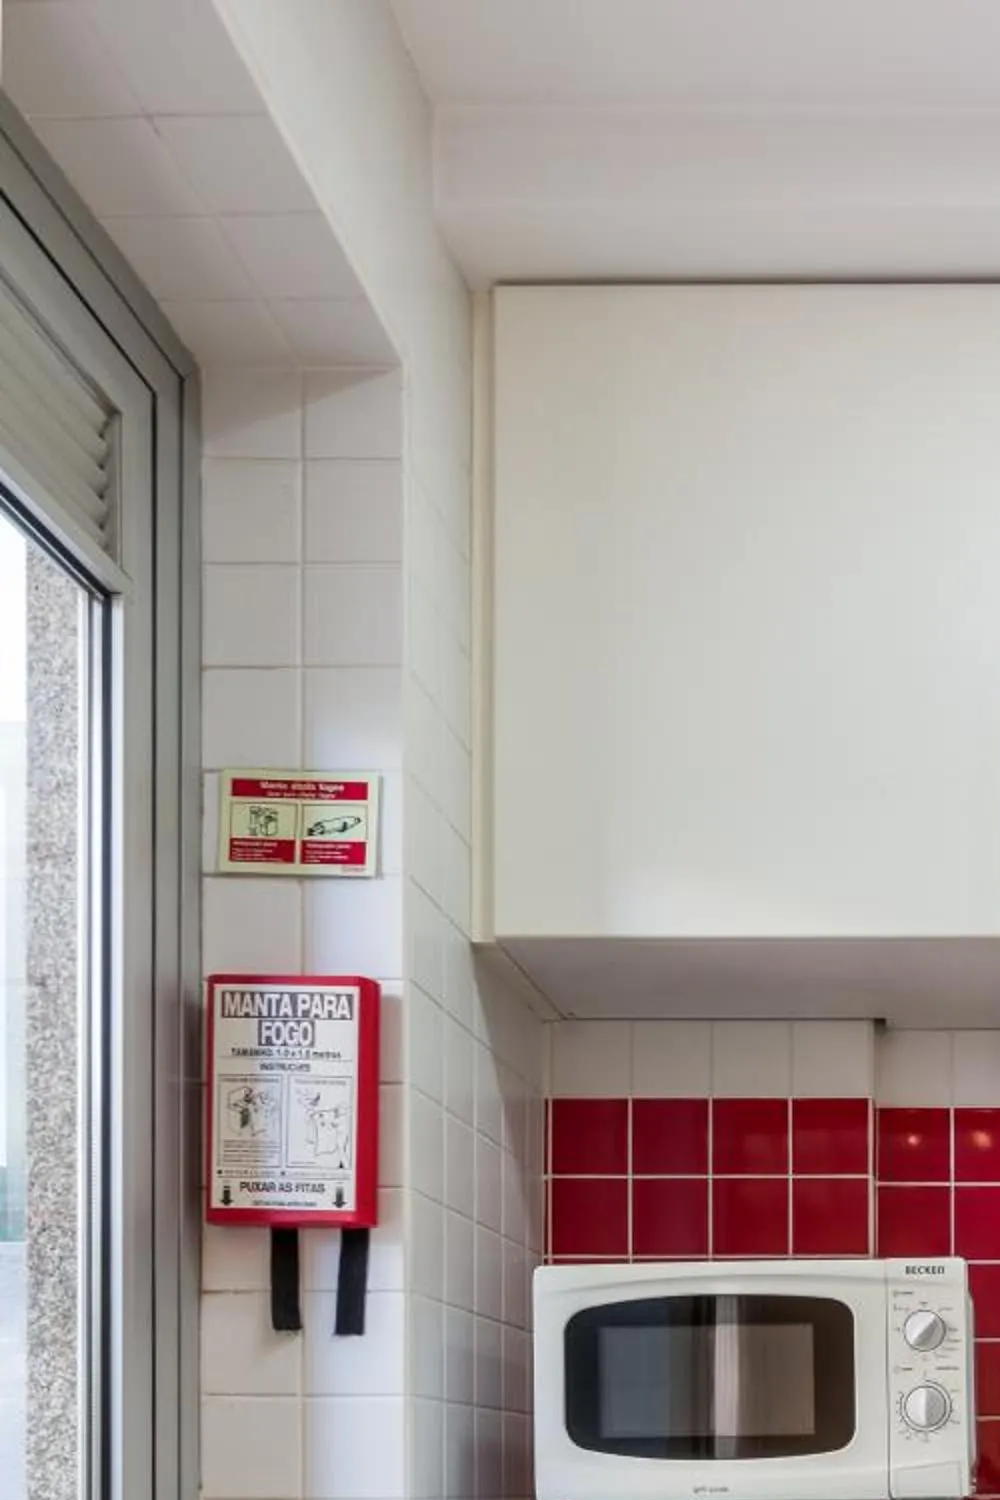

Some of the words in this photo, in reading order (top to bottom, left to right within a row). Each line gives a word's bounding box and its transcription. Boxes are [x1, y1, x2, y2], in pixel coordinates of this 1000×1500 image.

[223, 992, 293, 1017] MANTA
[298, 993, 351, 1018] PARA
[261, 1021, 313, 1046] FOGO
[239, 1181, 277, 1193] PUXAR
[278, 1182, 293, 1193] AS
[294, 1183, 326, 1194] FITAS
